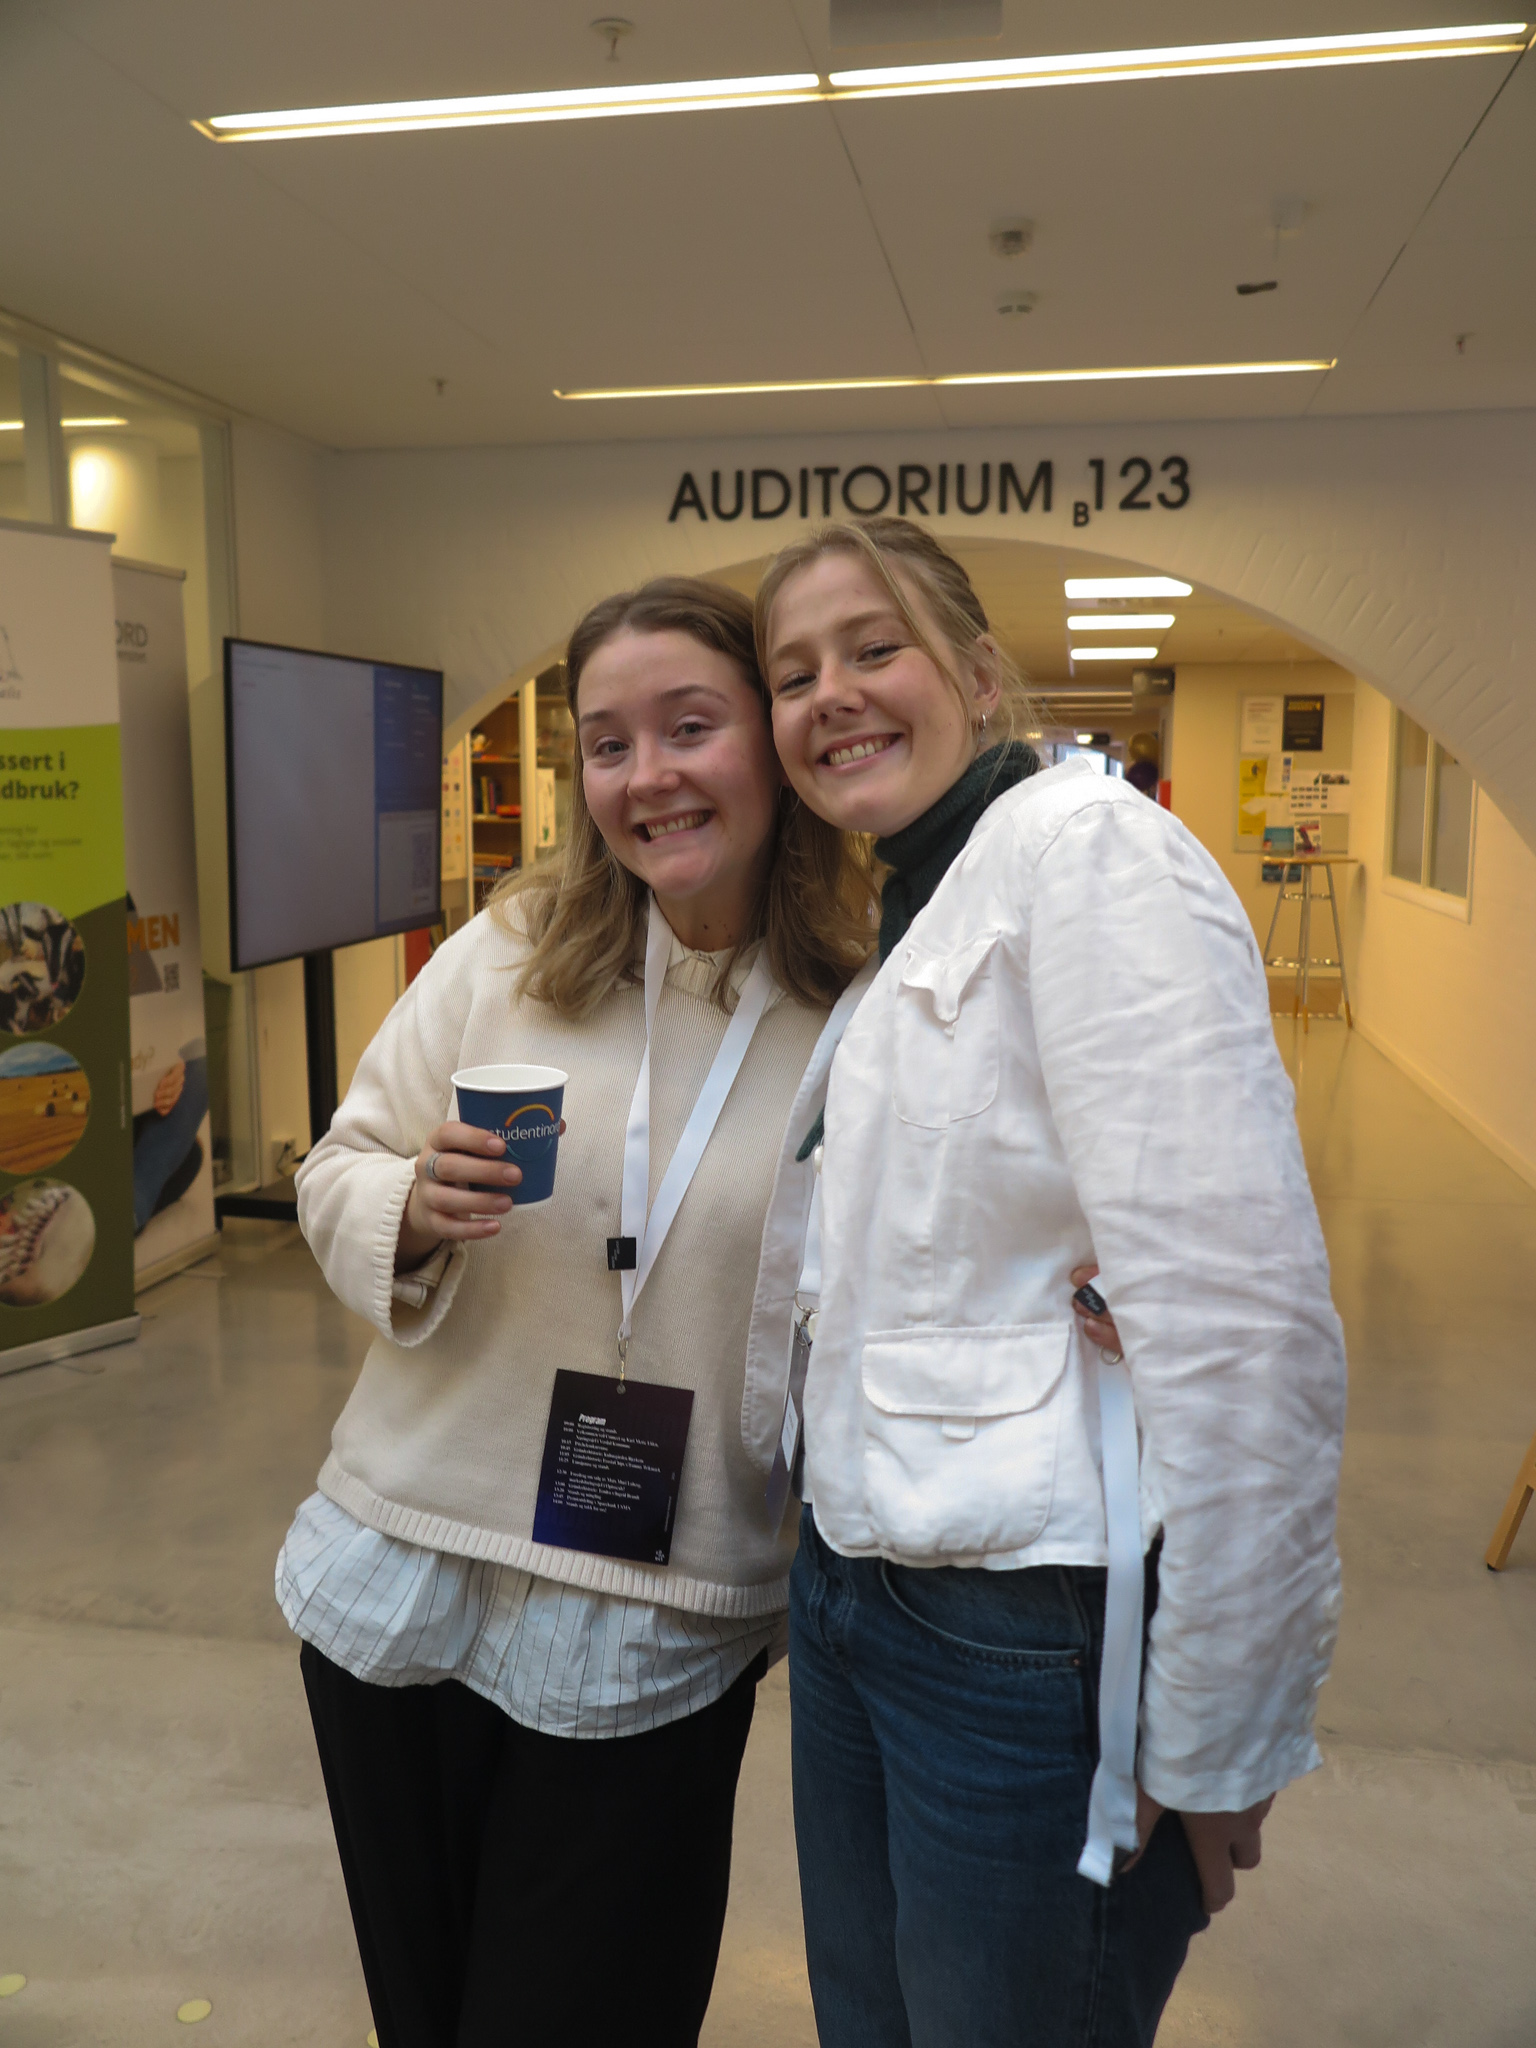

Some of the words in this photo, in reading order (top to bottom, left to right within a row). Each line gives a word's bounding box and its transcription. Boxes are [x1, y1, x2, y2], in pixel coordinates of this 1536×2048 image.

[668, 460, 1053, 522] AUDITORIUM
[1, 779, 79, 799] dbruk?
[127, 912, 180, 954] MEN
[578, 1413, 607, 1426] Program
